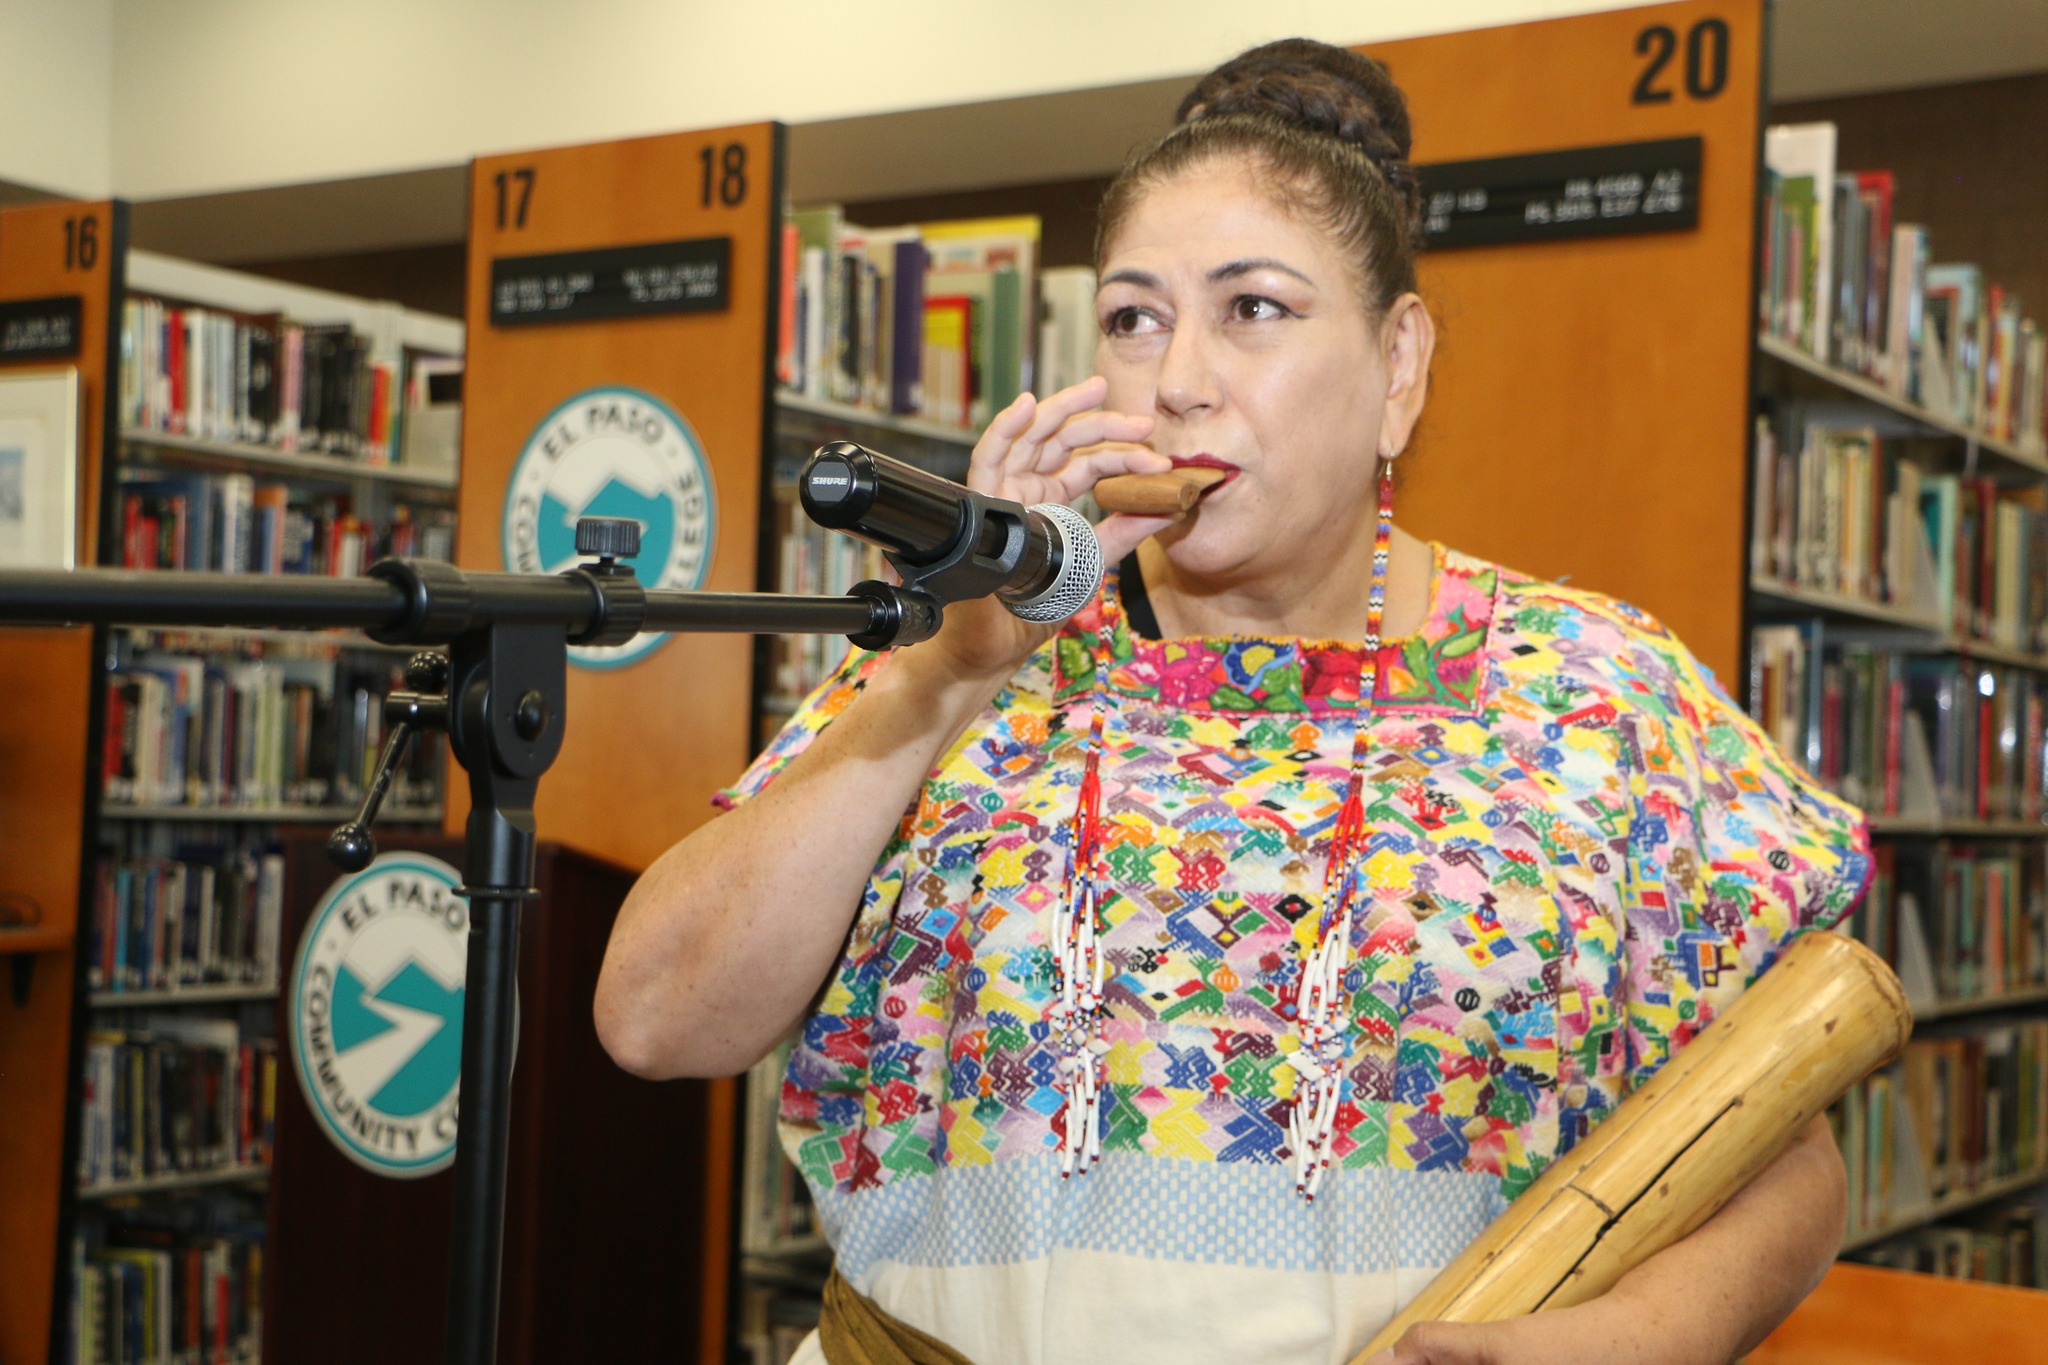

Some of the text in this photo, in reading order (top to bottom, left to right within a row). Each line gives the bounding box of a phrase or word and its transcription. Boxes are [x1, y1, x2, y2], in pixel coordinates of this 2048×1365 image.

[1631, 17, 1730, 106] 20
[493, 168, 536, 231] 17
[699, 142, 747, 208] 18
[64, 215, 99, 271] 16
[541, 404, 665, 464] EL PASO
[812, 476, 848, 486] SHURE
[339, 878, 467, 932] EL PASO
[306, 964, 420, 1152] COMMUNITY
